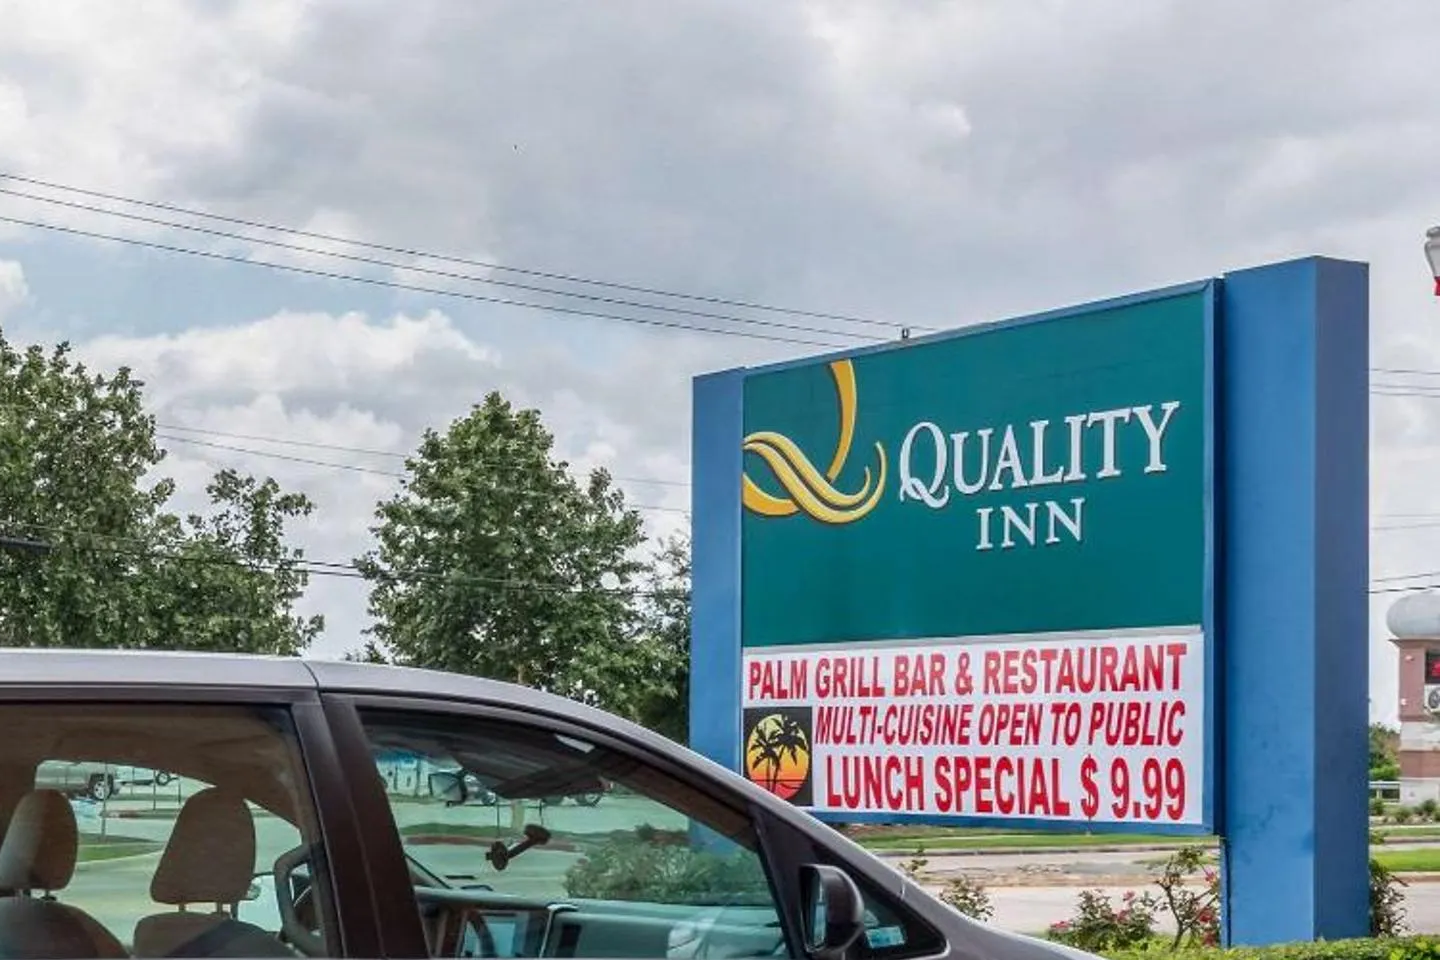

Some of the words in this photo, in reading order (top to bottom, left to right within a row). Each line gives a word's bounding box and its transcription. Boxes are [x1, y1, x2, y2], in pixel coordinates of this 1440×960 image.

[899, 401, 1180, 508] QUALITY
[976, 498, 1085, 551] INN
[748, 658, 808, 700] PALM
[815, 656, 886, 698] GRILL
[893, 653, 946, 697] BAR
[954, 651, 973, 695] &
[983, 643, 1187, 695] RESTAURANT
[815, 703, 974, 746] MULTI-CUISINE
[978, 703, 1043, 746] OPEN
[1050, 701, 1082, 746] TO
[1088, 700, 1186, 747] PUBLIC
[826, 754, 925, 811] LUNCH
[934, 755, 1071, 817] SPECIAL
[1110, 757, 1186, 821] 9.99
